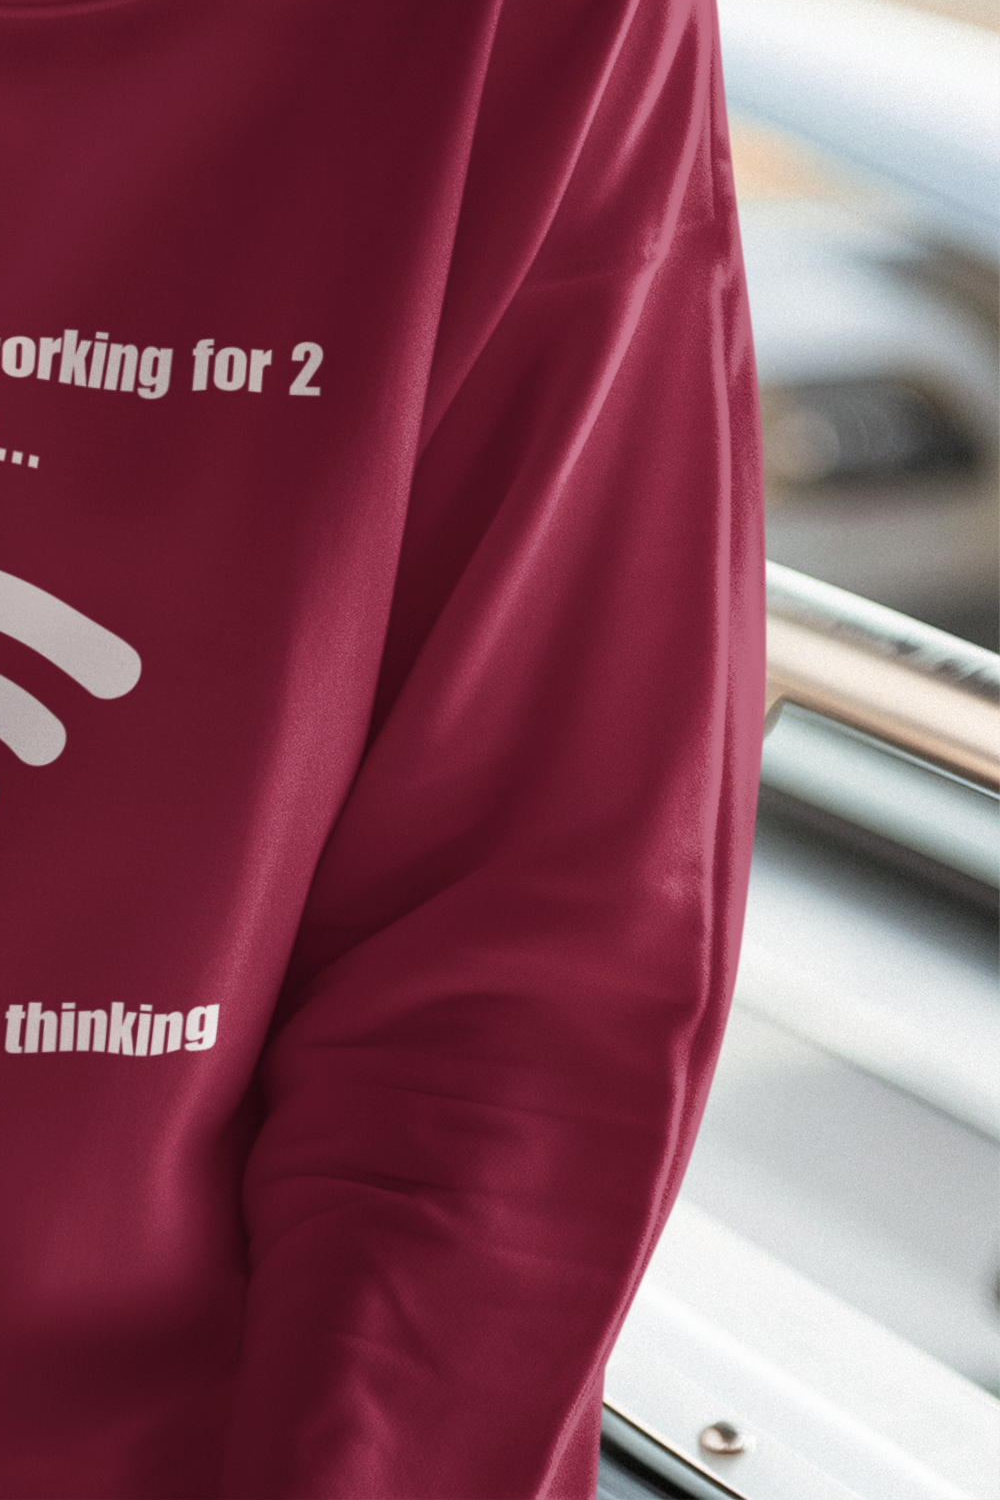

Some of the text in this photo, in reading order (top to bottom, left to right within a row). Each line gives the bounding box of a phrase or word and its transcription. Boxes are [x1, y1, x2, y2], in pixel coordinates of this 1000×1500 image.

[191, 338, 273, 393] for
[288, 341, 324, 397] 2
[4, 1001, 221, 1057] thinking
